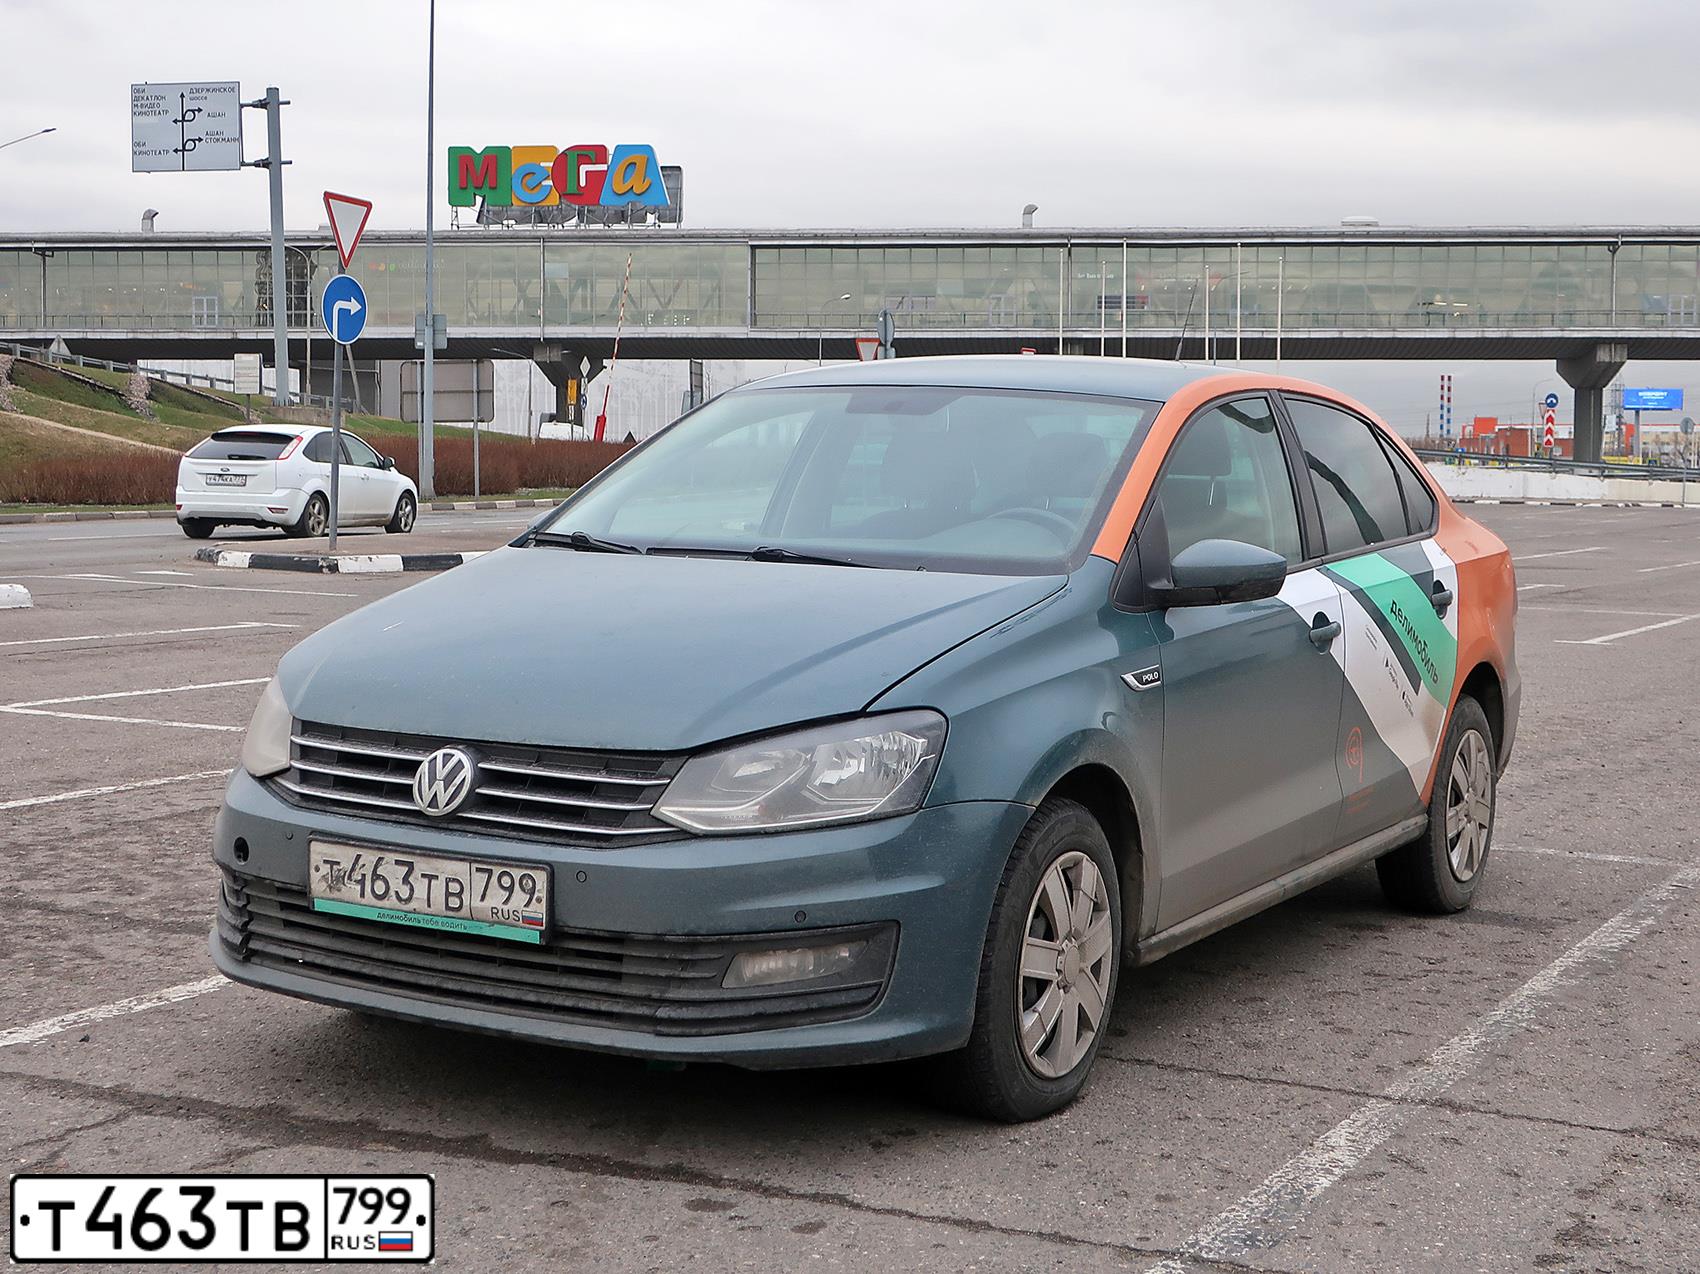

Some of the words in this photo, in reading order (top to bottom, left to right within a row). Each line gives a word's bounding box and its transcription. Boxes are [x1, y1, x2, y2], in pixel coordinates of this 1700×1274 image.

[189, 87, 236, 95] ДЗЕРЖИНСКОЕ
[1389, 599, 1439, 685] делимобиль
[1142, 671, 1159, 683] POLO
[475, 866, 538, 908] 799
[376, 911, 421, 924] делимобиль
[491, 906, 521, 922] RUS
